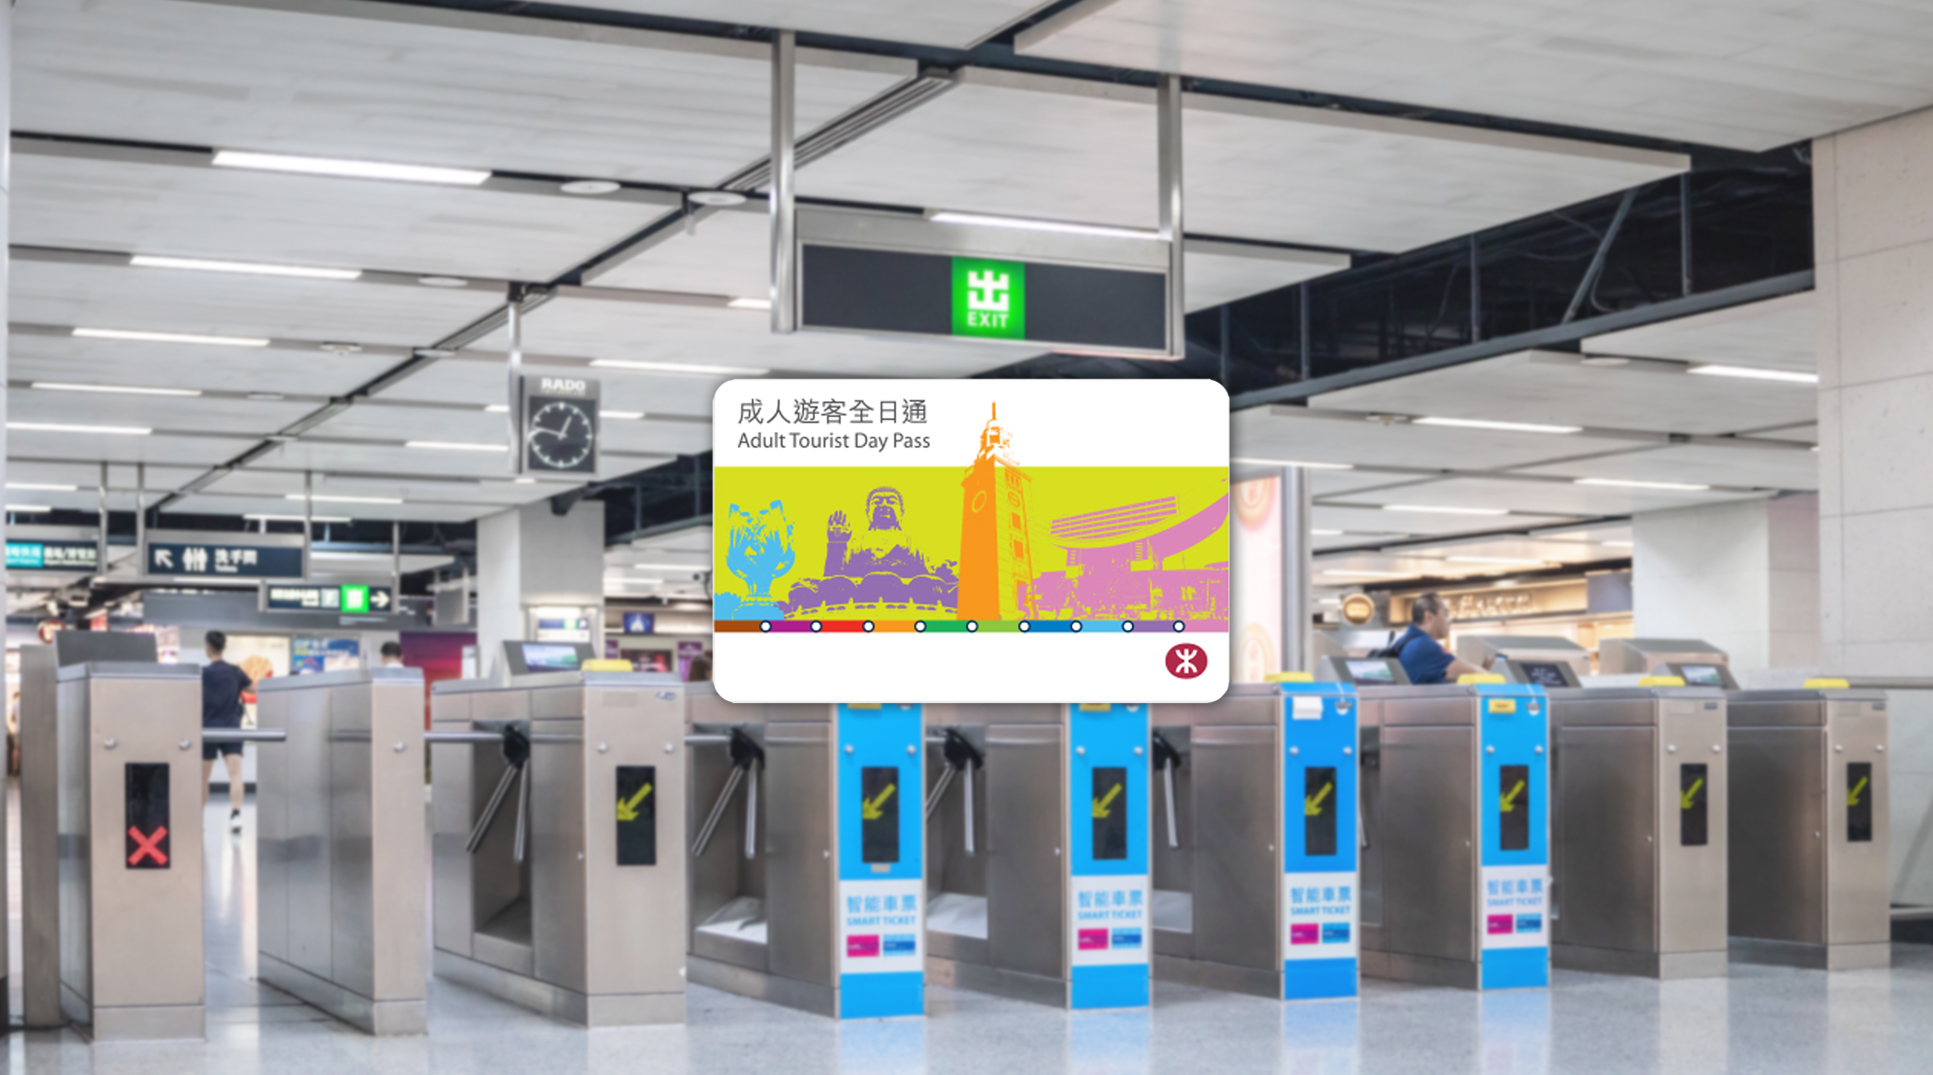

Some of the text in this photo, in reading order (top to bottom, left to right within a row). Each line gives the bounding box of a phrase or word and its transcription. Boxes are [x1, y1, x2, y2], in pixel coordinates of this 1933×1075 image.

[968, 270, 1009, 312] 出
[968, 311, 1008, 328] EXIT
[541, 378, 586, 391] RADO
[846, 894, 917, 913] 智能車票
[1078, 889, 1143, 907] 智能車票
[1290, 886, 1351, 904] 智能車票
[1078, 909, 1142, 920] SMART TICKET
[1290, 905, 1351, 916] SMART TICKET
[847, 915, 916, 926] SMART TICKET
